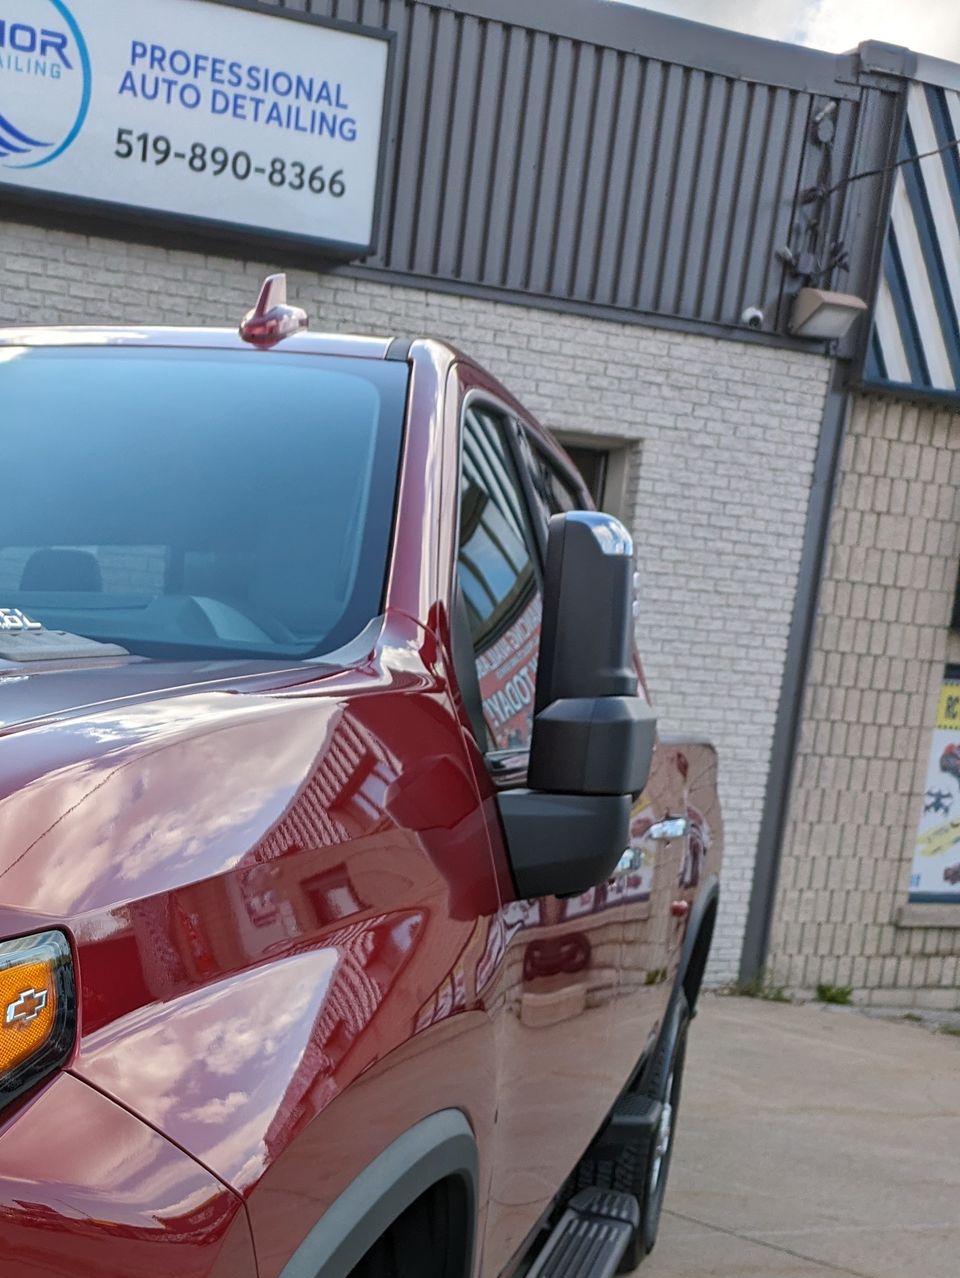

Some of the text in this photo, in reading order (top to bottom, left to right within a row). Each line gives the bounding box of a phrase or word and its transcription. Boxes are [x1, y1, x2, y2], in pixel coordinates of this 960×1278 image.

[118, 70, 357, 142] AUTO DETAILING
[130, 40, 348, 109] PROFESSIONAL
[114, 128, 346, 198] 519-890-8366
